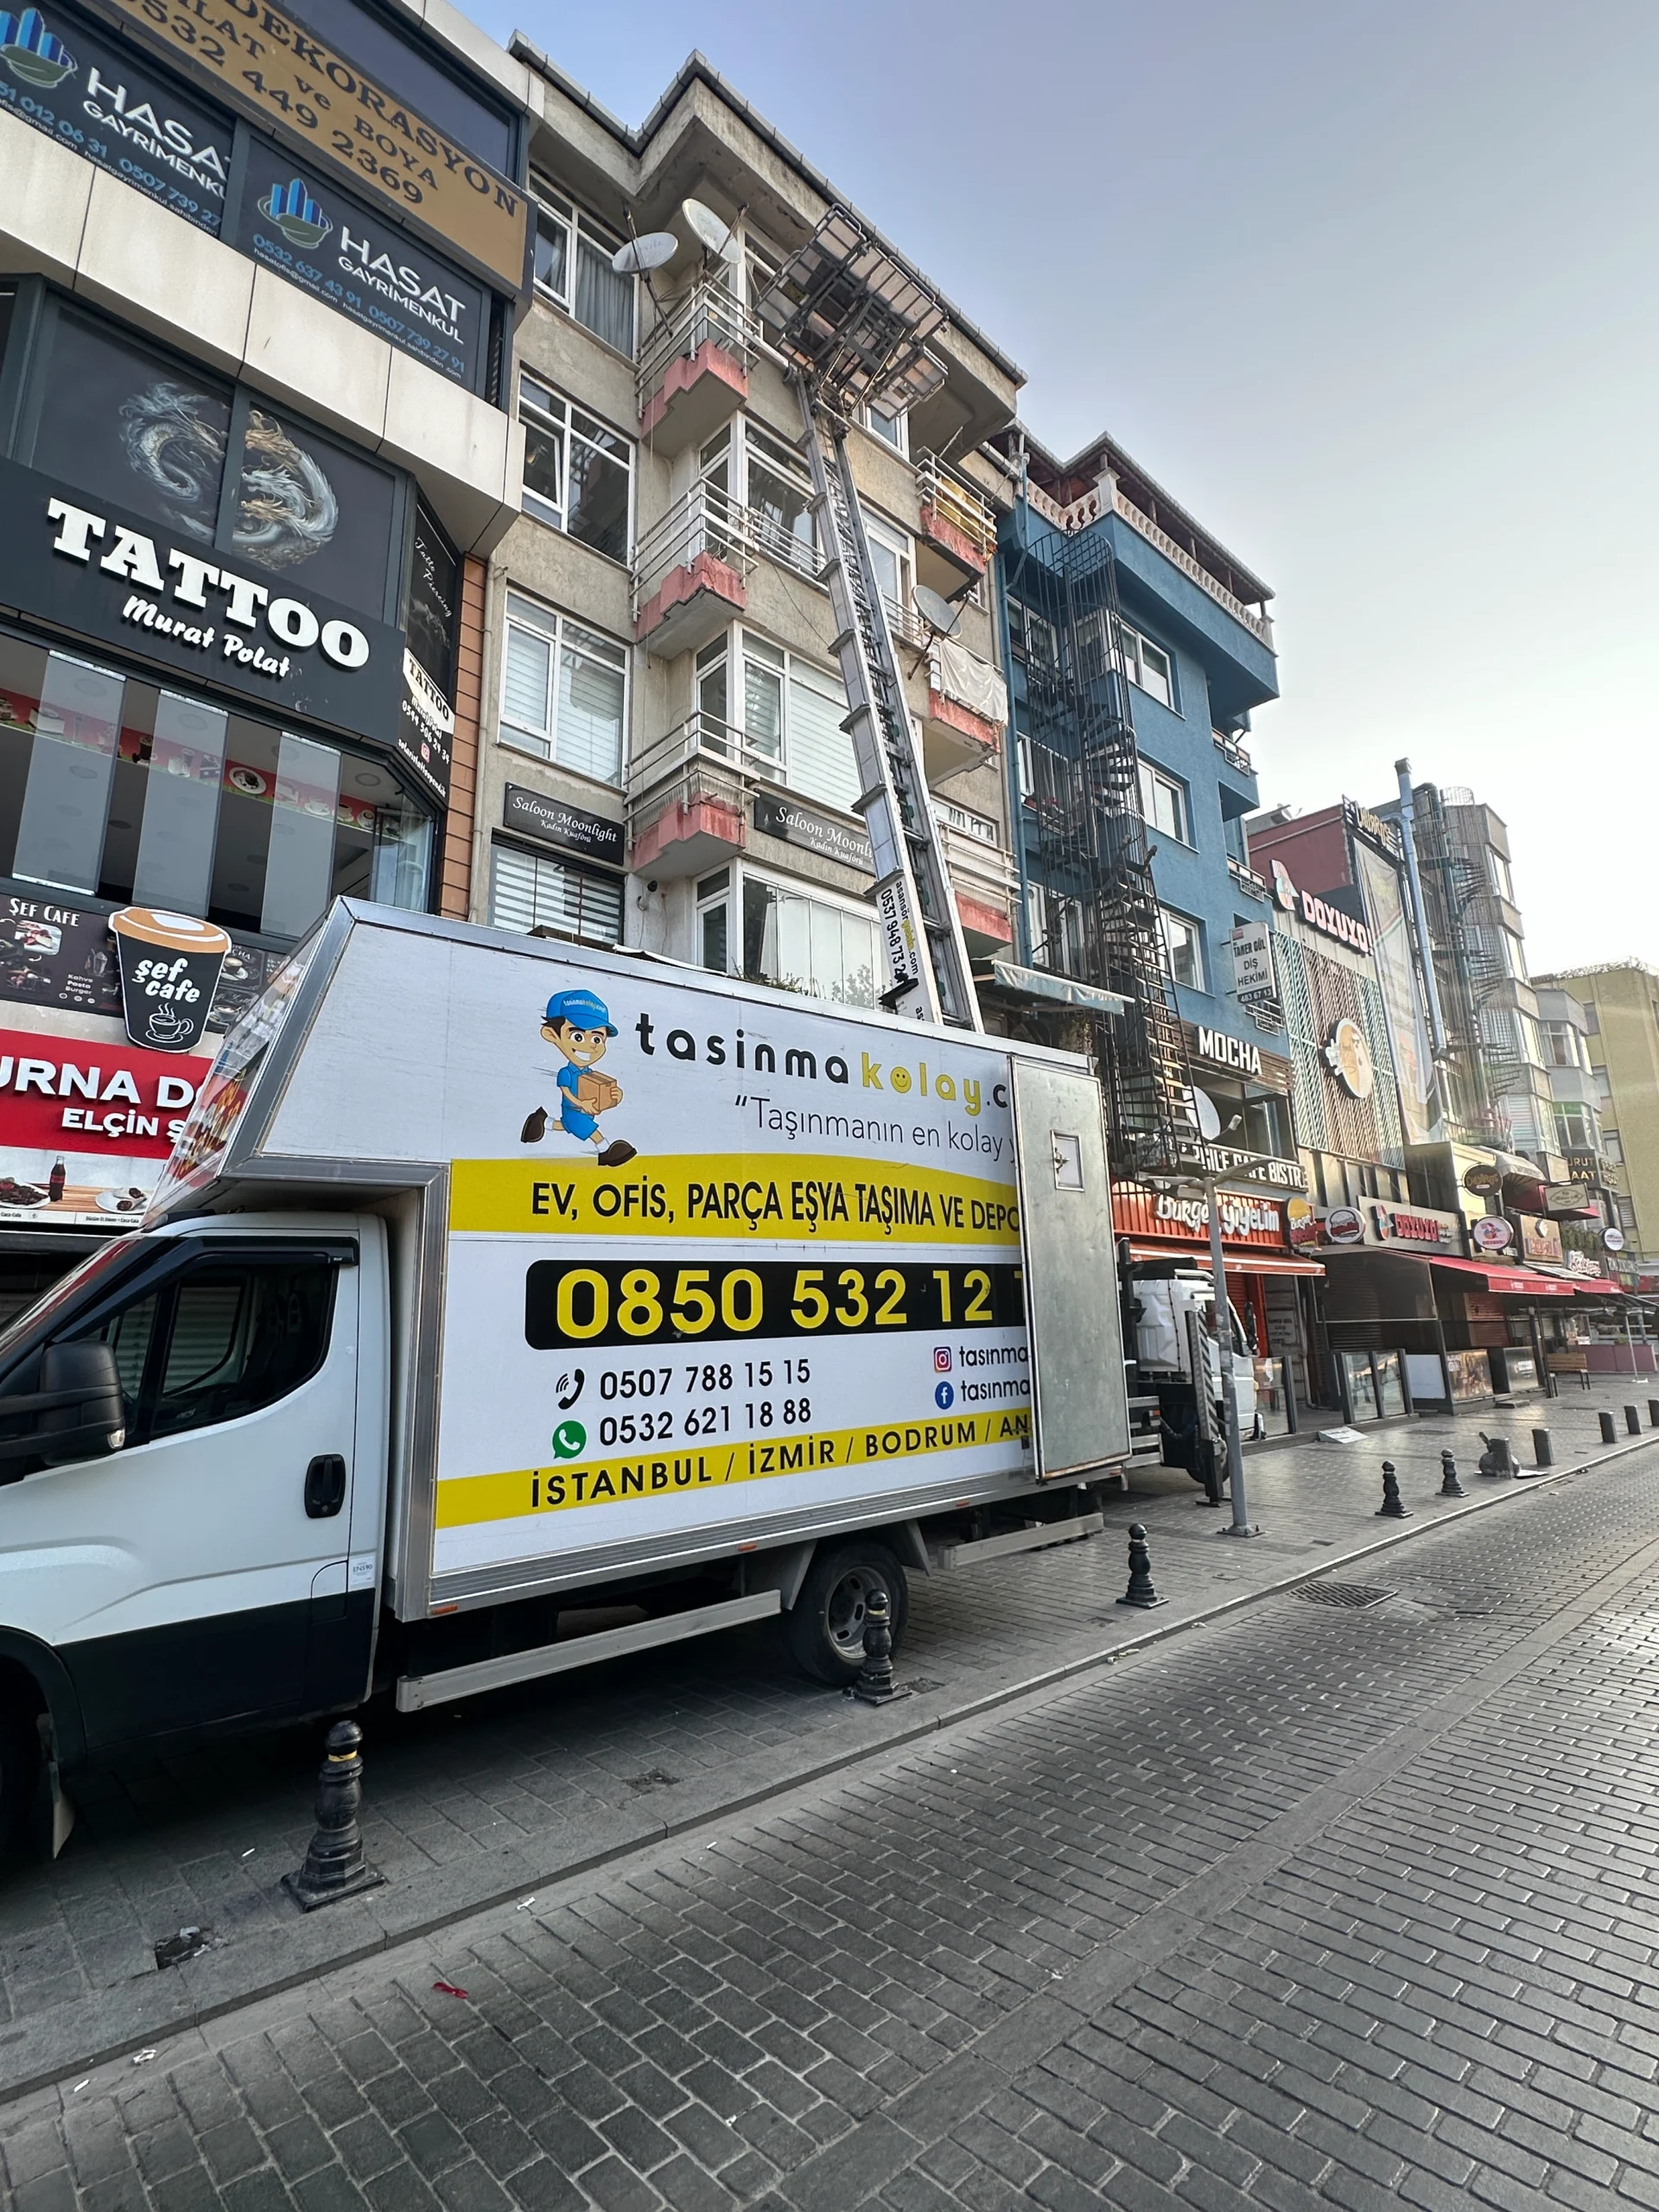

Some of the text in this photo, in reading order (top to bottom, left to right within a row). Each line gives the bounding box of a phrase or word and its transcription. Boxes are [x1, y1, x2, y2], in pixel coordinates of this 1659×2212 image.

[141, 0, 423, 204] 532 449 2369
[87, 67, 231, 181] HASA
[294, 74, 331, 111] ve
[353, 114, 439, 191] BOYA
[20, 96, 54, 126] 012
[58, 119, 84, 143] 06
[88, 137, 107, 158] 31
[118, 158, 166, 191] 0507
[168, 187, 199, 213] 739
[201, 208, 221, 226] 27
[340, 226, 467, 322] HASAT
[252, 233, 465, 373] 0532 637 43 91 0507 739 27 91
[338, 256, 465, 345] GAYRİMENKUL
[48, 497, 370, 669] TATTOO
[122, 594, 292, 679] Murat Polat
[409, 658, 450, 722] TATTOO
[512, 797, 618, 842] Saloon Moonlight
[540, 819, 562, 833] Kadın
[775, 806, 874, 864] Saloon Moonli
[810, 836, 833, 854] Kadın
[9, 898, 80, 927] ŞEF CAFE
[880, 888, 897, 920] 0537
[232, 949, 251, 961] CHA
[887, 920, 901, 948] 948
[892, 945, 905, 964] 73
[1253, 938, 1266, 952] GÜL
[131, 957, 189, 984] şef
[1237, 968, 1268, 987] HEKİMİ
[1243, 957, 1258, 970] DİŞ
[145, 978, 201, 1004] cafe
[1263, 988, 1272, 996] 13
[915, 1006, 925, 1021] as
[1198, 1026, 1262, 1075] MOCHA
[156, 1076, 204, 1109] D
[61, 1106, 159, 1138] ELÇİN
[912, 1126, 940, 1147] en
[949, 1120, 1003, 1162] kolay
[531, 1174, 1020, 1236] EV, OFİS, PARÇA EŞYA TAŞIMA VE DEPO
[1156, 1193, 1210, 1233] Burge
[556, 1268, 764, 1339] 0850
[790, 1268, 907, 1330] 532
[932, 1269, 994, 1324] 12
[599, 1358, 811, 1401] 0507 788 15 15
[599, 1397, 812, 1447] 0532 621 18 88
[531, 1455, 712, 1508] İSTANBUL
[748, 1435, 836, 1473] İZMİR
[866, 1421, 976, 1458] BODRUM
